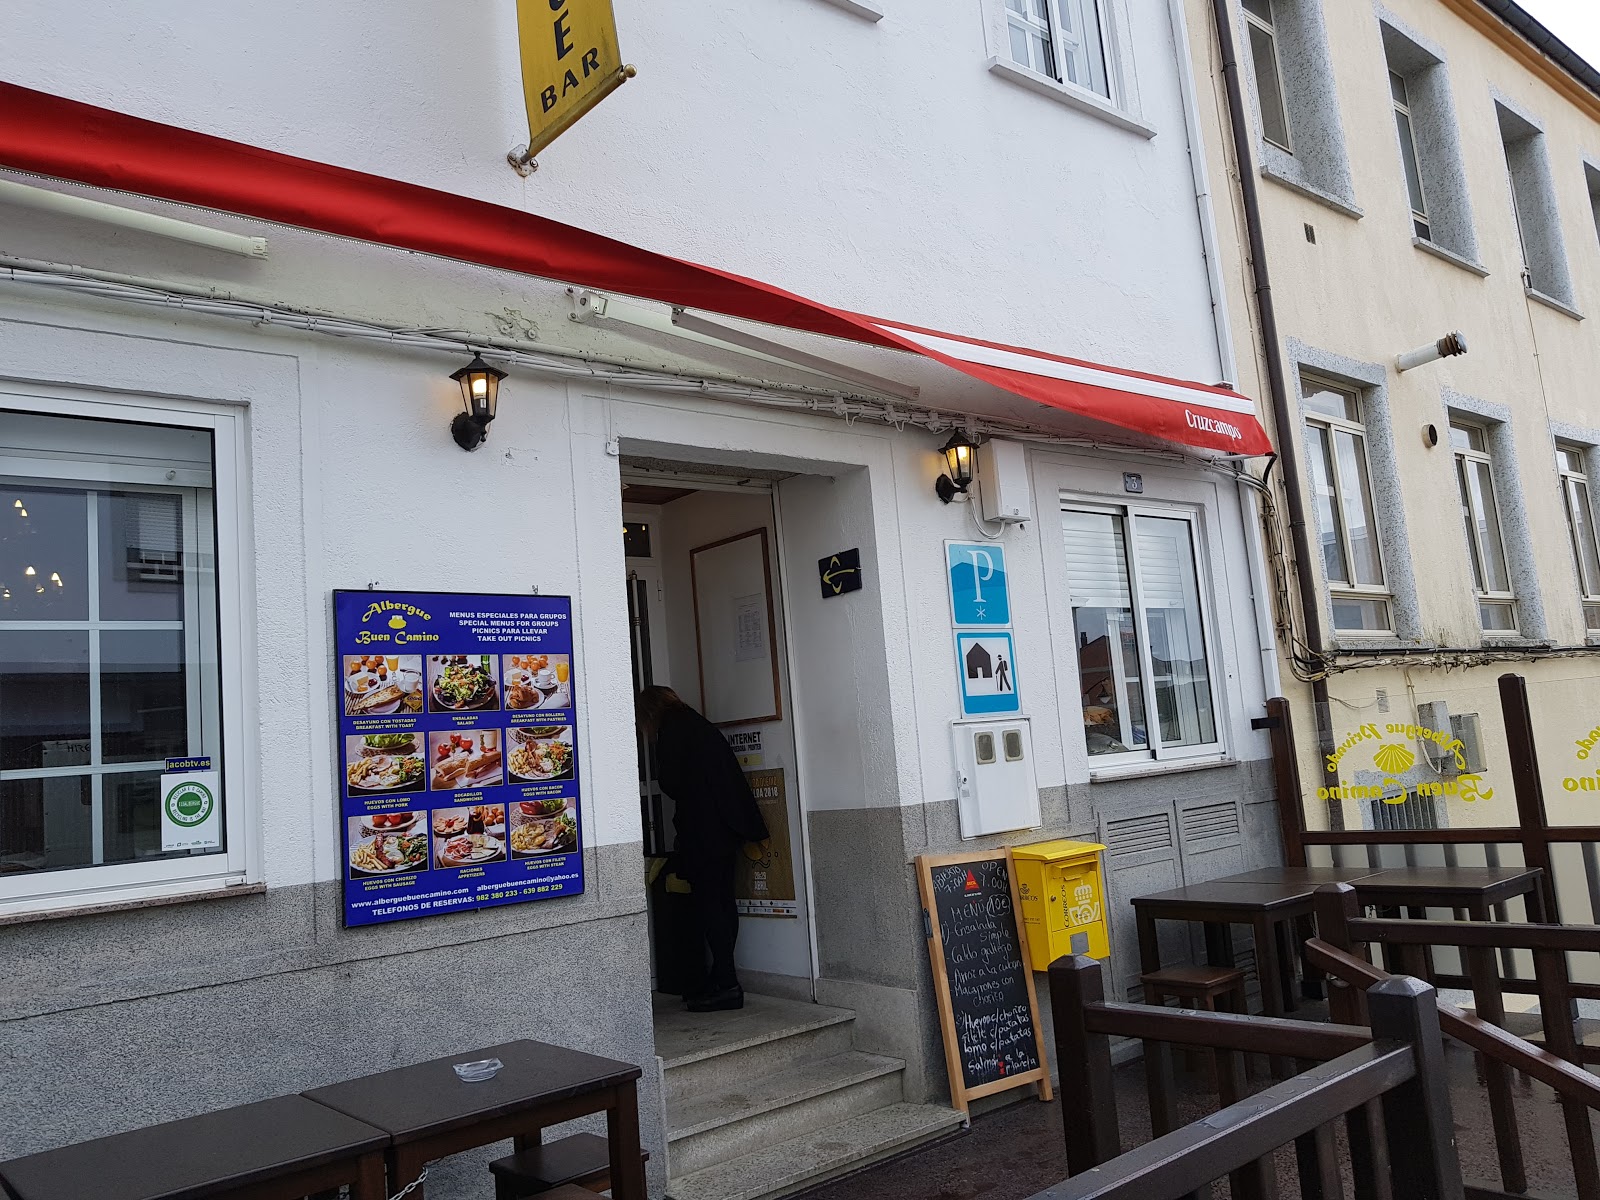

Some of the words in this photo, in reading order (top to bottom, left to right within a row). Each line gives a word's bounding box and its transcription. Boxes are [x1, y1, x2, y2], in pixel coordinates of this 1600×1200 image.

[540, 47, 600, 113] BAR
[1185, 409, 1242, 441] Cruzcampo
[1131, 476, 1138, 490] 3
[966, 550, 994, 603] P
[362, 600, 431, 622] Albergue
[449, 611, 475, 619] MENUS
[355, 630, 390, 644] Buen
[395, 630, 439, 644] Camino
[727, 732, 761, 745] INTERNET
[166, 758, 211, 770] jacobtv.es
[764, 786, 779, 797] 2018
[933, 866, 961, 892] ABIERTO
[981, 861, 1008, 880] OPEN
[351, 887, 469, 909] www.alberguebuencamino.com
[477, 873, 579, 892] alberguebuencamino@yahoo.es
[372, 903, 419, 916] TELEFONOS
[421, 901, 431, 909] DE
[433, 896, 475, 908] RESERVAS:
[476, 893, 489, 902] 982
[491, 892, 504, 900] 380
[537, 885, 550, 893] 882
[551, 883, 563, 891] 229
[1061, 884, 1070, 928] CORREOS
[951, 943, 978, 963] Caldo
[954, 968, 977, 986] Arroz
[1001, 976, 1014, 986] con
